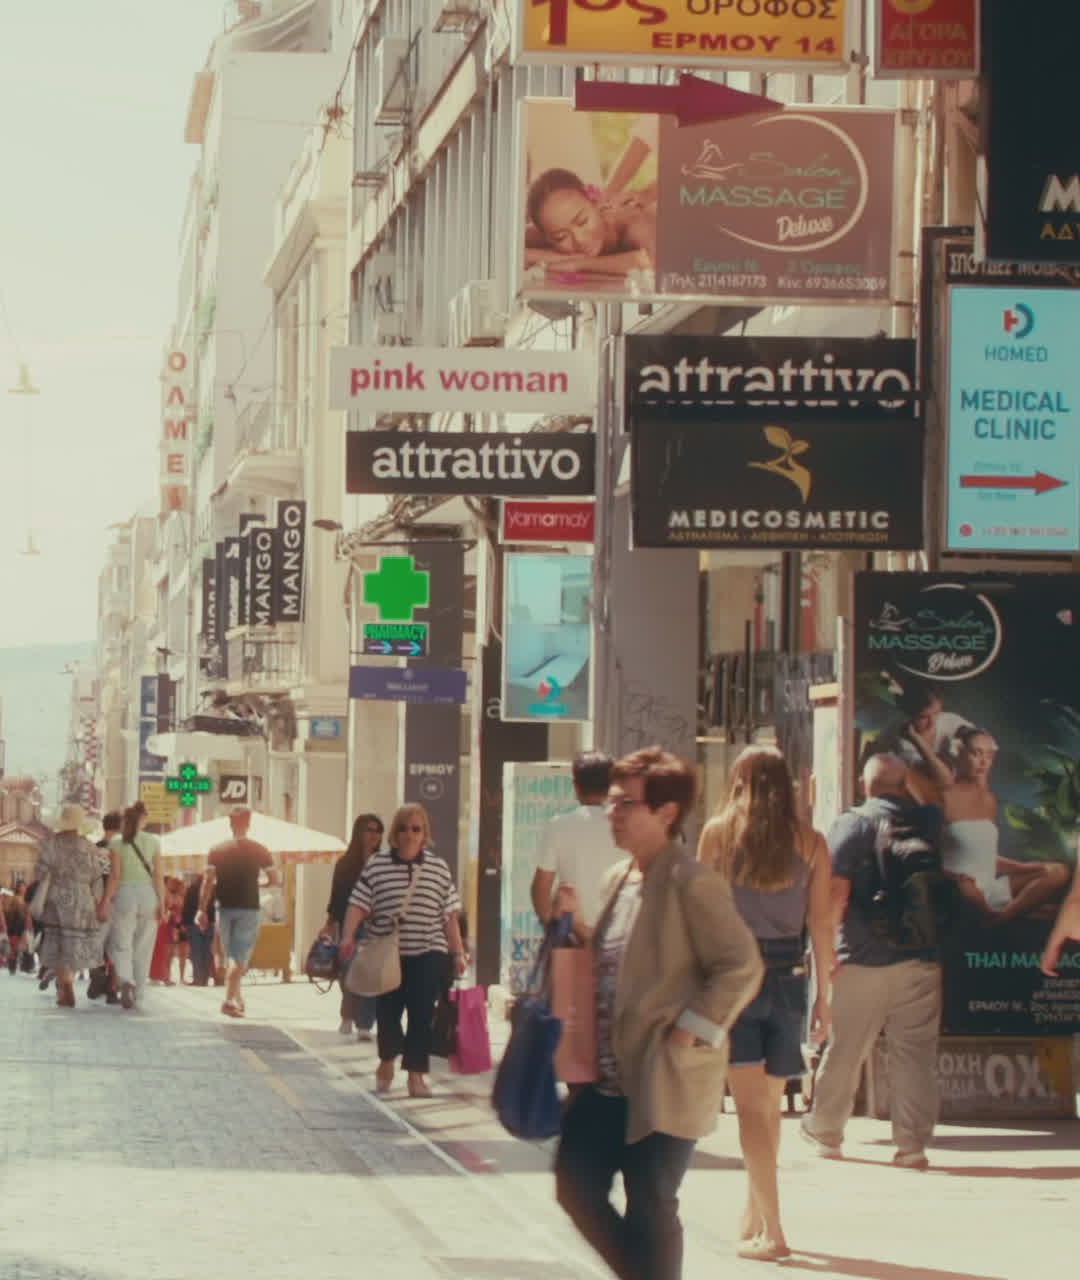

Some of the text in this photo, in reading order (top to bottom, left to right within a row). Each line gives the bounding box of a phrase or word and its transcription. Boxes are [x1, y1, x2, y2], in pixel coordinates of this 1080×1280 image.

[651, 31, 837, 54] ΕΡΜΟΥ 14
[679, 184, 849, 209] MASSAGE
[776, 214, 834, 241] Deluxe
[984, 344, 1049, 362] HOMED
[350, 359, 569, 397] pink woman
[639, 353, 910, 409] attrattivo
[960, 388, 1070, 413] MEDICAL
[973, 417, 1057, 441] CLINIC
[371, 438, 581, 480] attrattivo
[669, 509, 889, 529] MEDICOSMETIC
[282, 504, 302, 616] MANGO
[255, 530, 272, 628] MANGO
[364, 623, 427, 641] PHARMACY
[869, 634, 988, 650] MASSAGE
[222, 780, 247, 799] JD
[965, 952, 1009, 969] THAI
